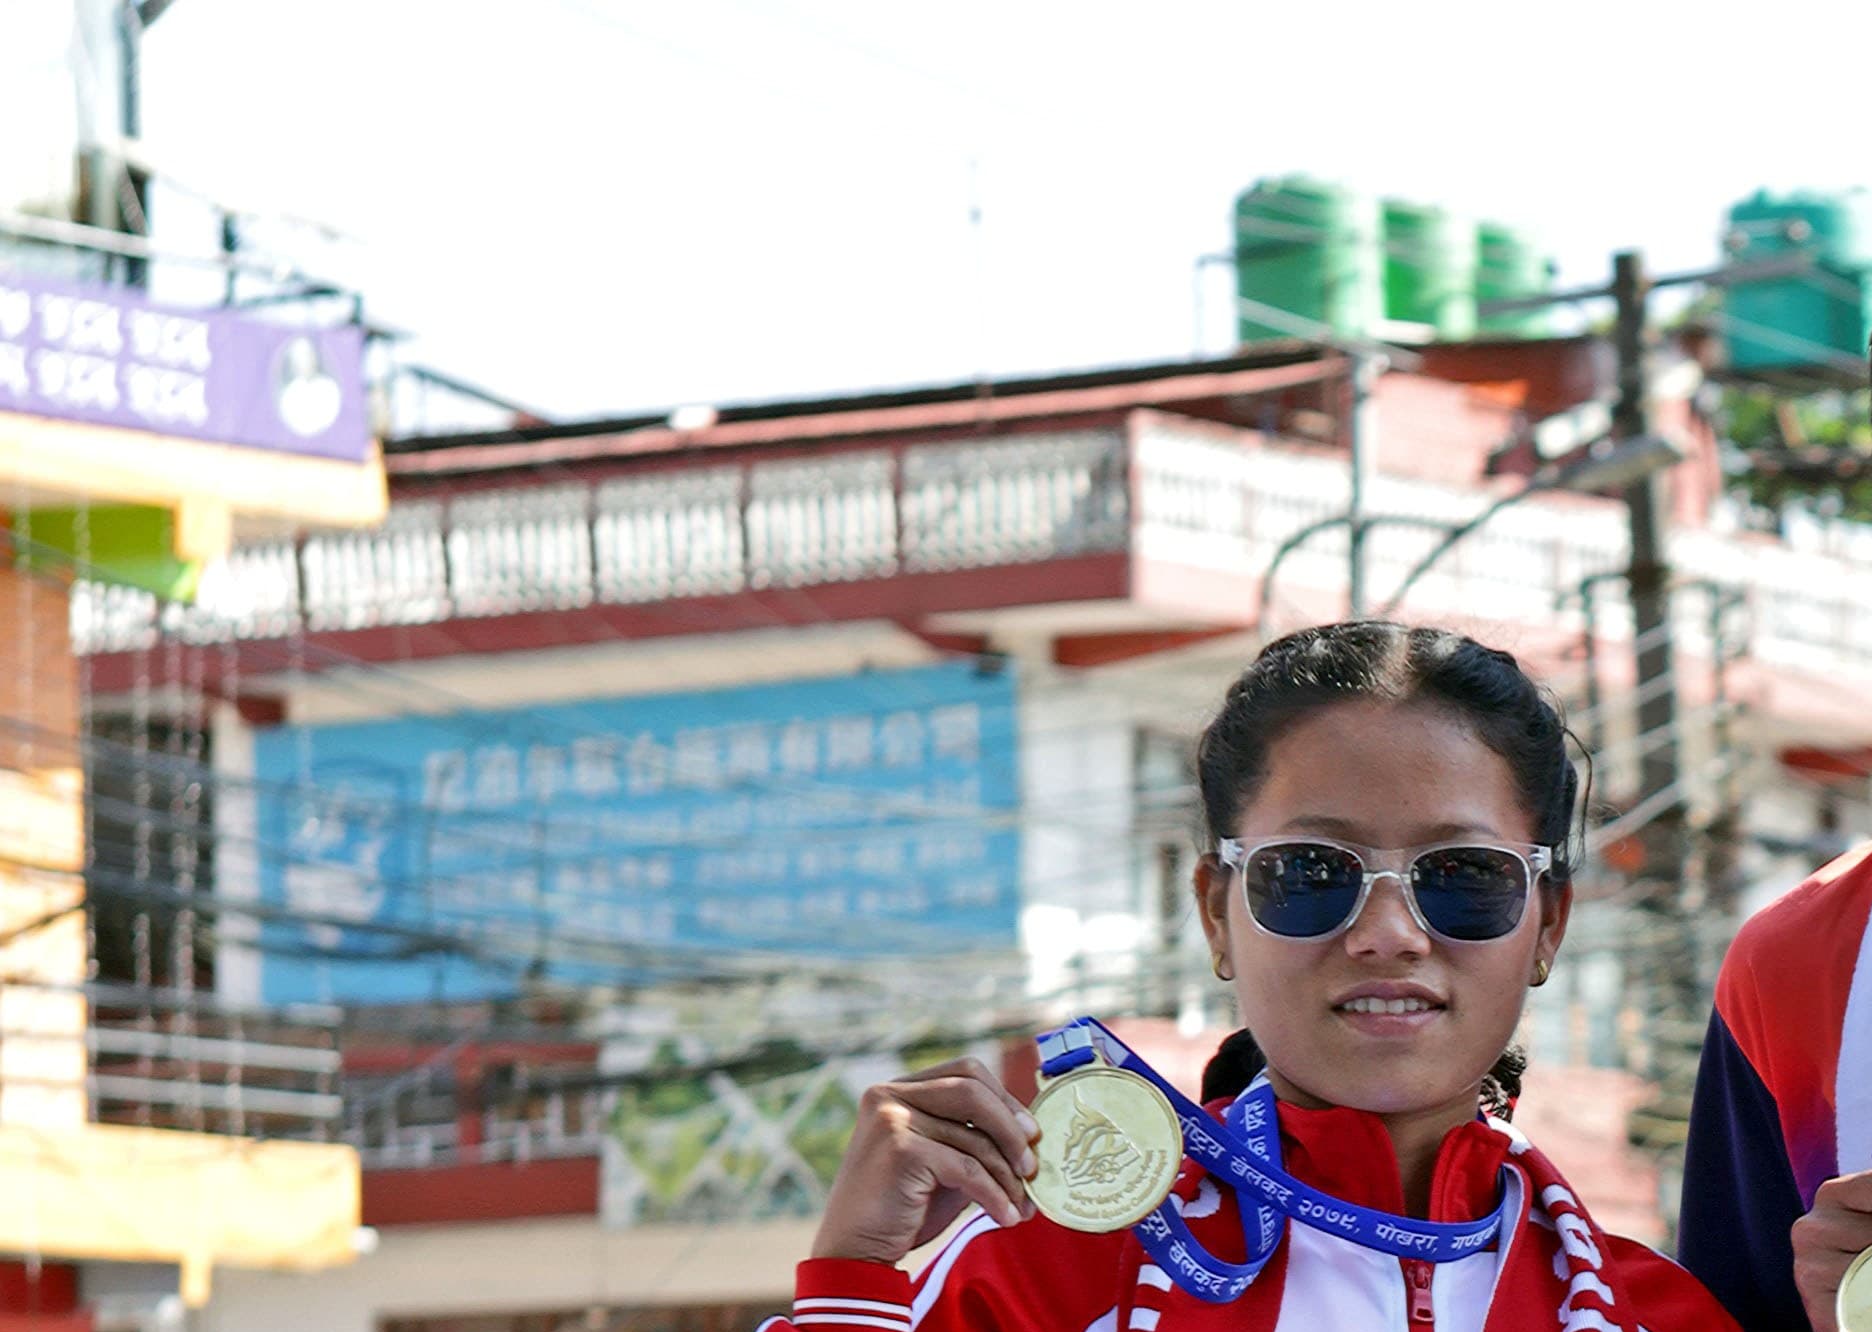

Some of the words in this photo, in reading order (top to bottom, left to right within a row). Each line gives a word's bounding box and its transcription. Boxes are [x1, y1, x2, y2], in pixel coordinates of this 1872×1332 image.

[1230, 1152, 1295, 1209] खेलकुद
[1375, 1222, 1440, 1253] पोखरा,
[1168, 1238, 1230, 1297] खेलकुद
